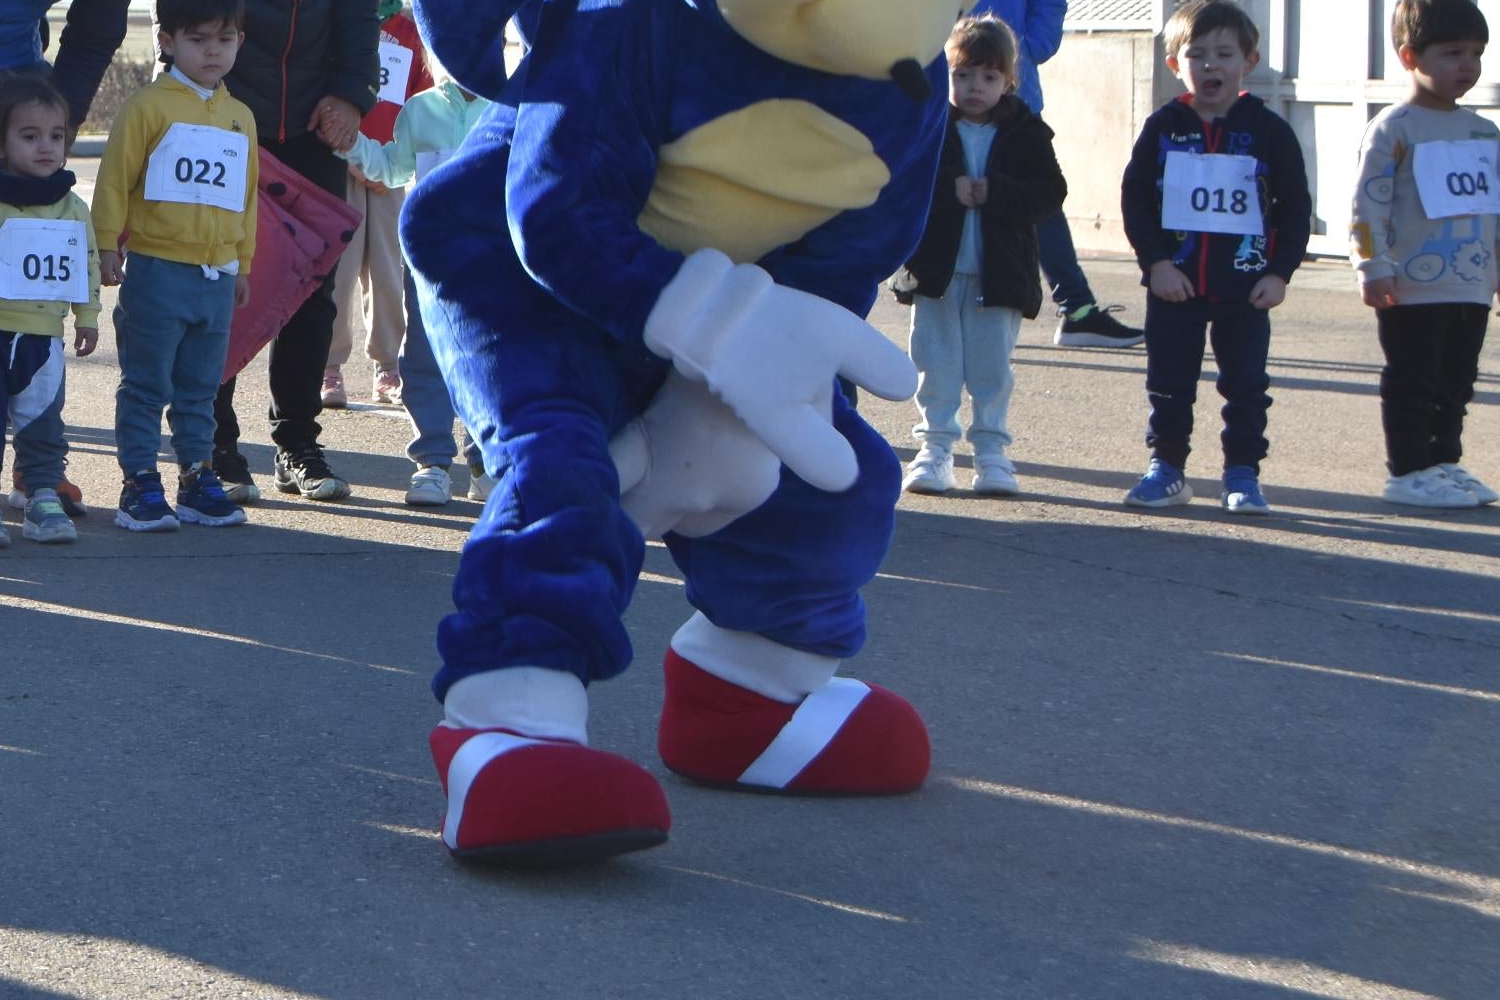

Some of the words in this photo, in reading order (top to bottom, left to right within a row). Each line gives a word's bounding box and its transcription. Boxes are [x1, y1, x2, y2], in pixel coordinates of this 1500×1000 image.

[174, 157, 226, 188] 022
[1446, 171, 1489, 196] 004
[1190, 187, 1248, 215] 018
[23, 253, 71, 282] 015
